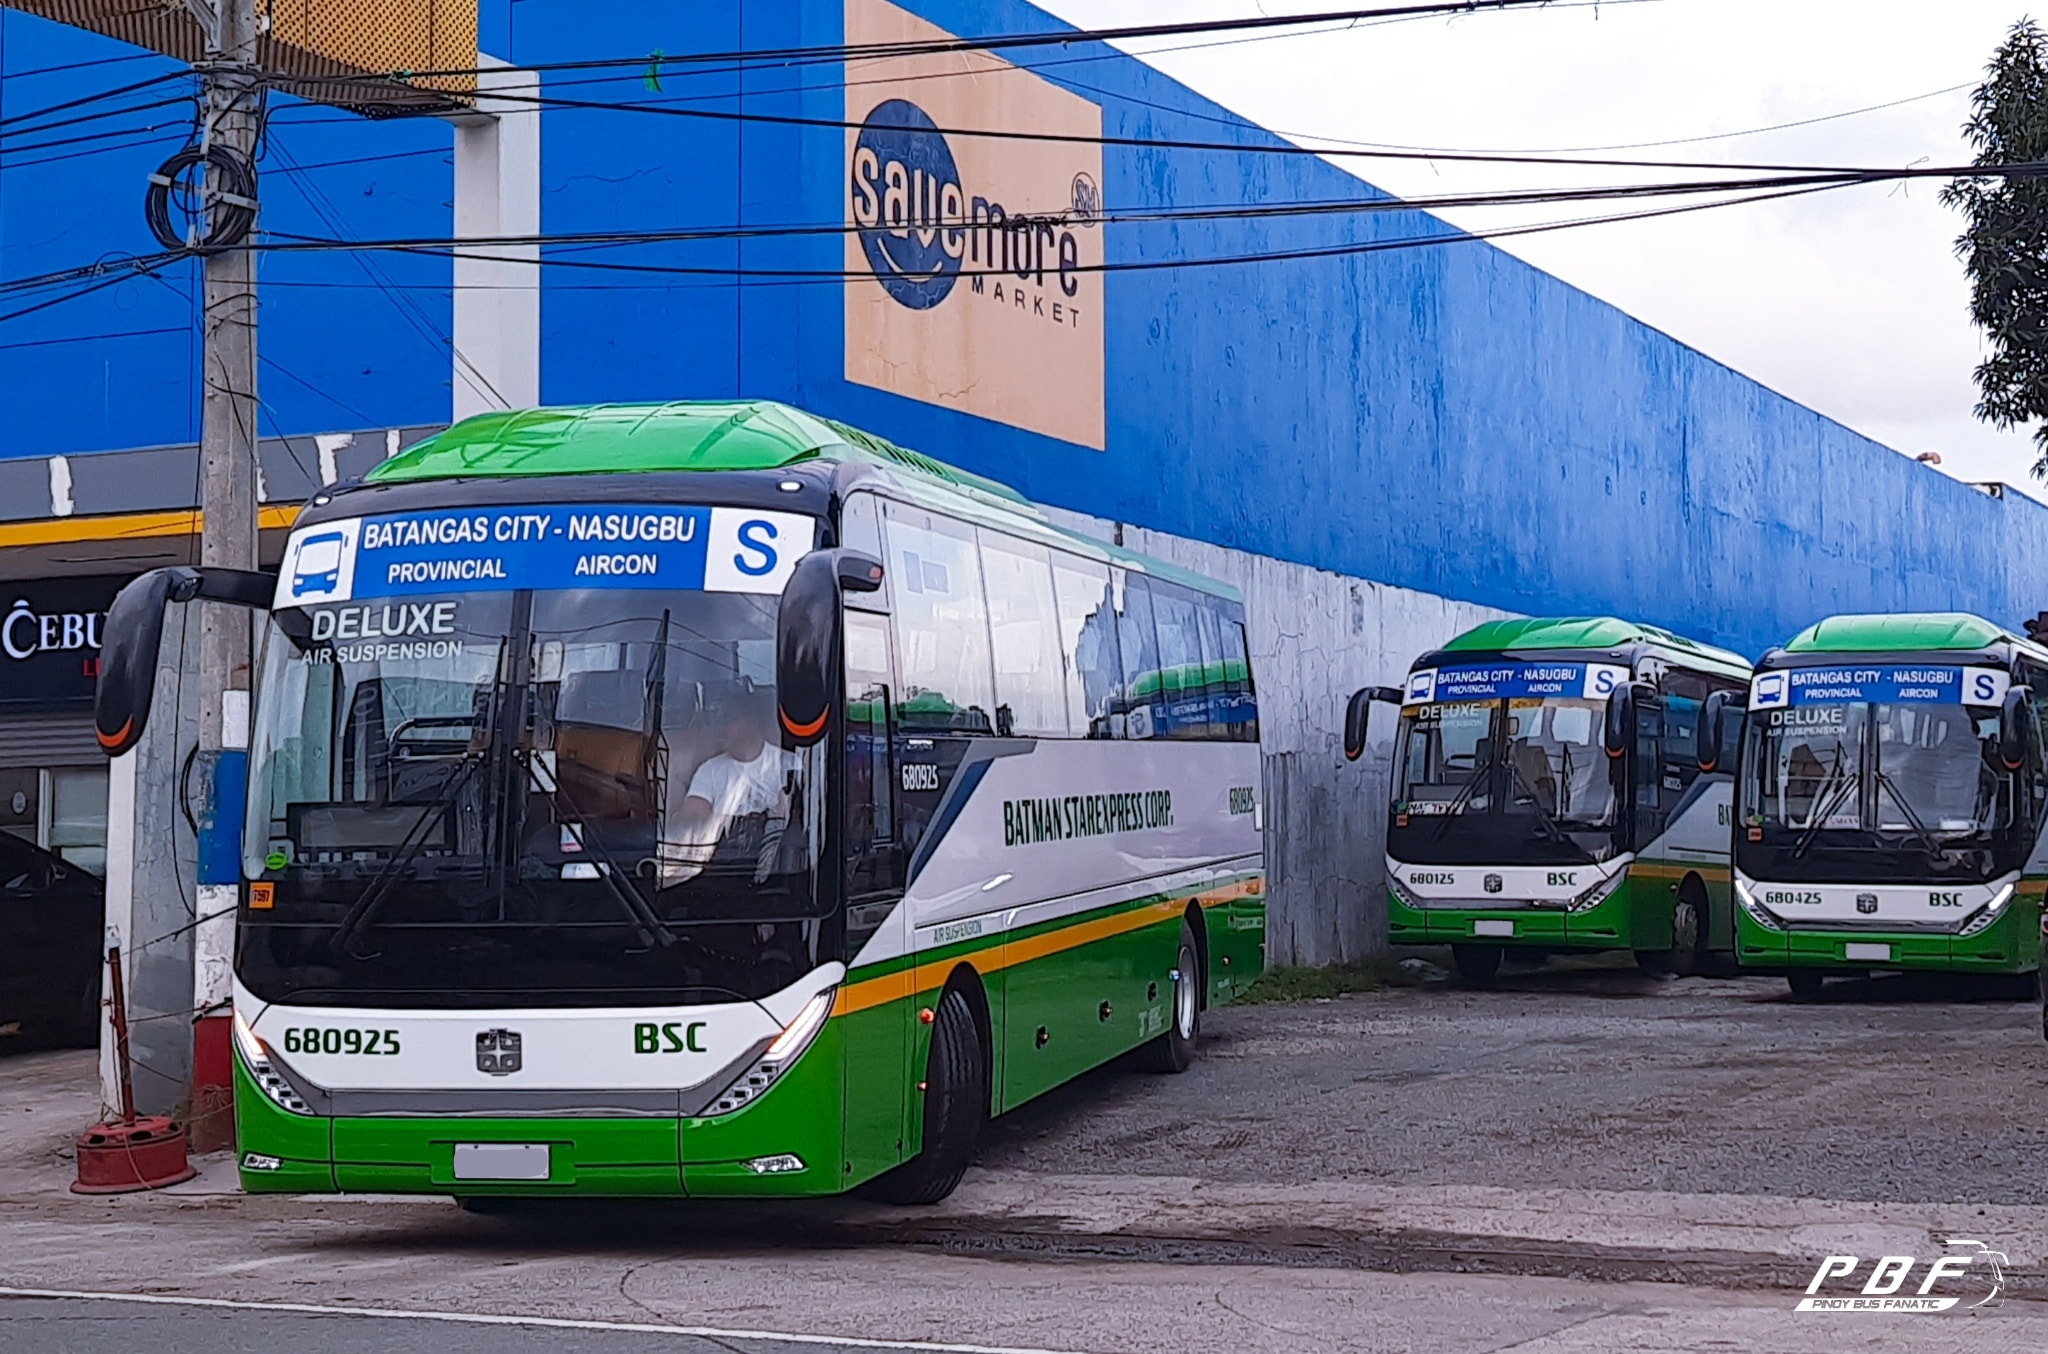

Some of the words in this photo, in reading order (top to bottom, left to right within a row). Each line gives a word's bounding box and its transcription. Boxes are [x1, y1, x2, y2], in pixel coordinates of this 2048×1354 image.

[971, 275, 1080, 328] MARKET
[363, 516, 489, 550] BATANGAS
[494, 514, 551, 542] CITY
[568, 514, 696, 543] NASUGBU
[734, 519, 778, 577] S
[387, 558, 507, 584] PROVINCIAL
[574, 553, 657, 576] AIRCON
[311, 602, 457, 642] DELUXE
[301, 647, 333, 666] AIR
[336, 640, 463, 665] SUSPENSION
[1437, 670, 1489, 685] BATANGAS
[1490, 669, 1515, 683] CITY
[1523, 668, 1577, 682] NASUGBU
[1594, 670, 1615, 694] S
[1791, 671, 1852, 686] BATANGAS
[1854, 670, 1881, 684] CITY
[1893, 670, 1954, 684] NASUGBU
[1973, 674, 1995, 700] S
[1447, 684, 1496, 695] PROVINCIAL
[1527, 683, 1562, 694] AIRCON
[1805, 687, 1863, 699] PROVINCIAL
[1898, 688, 1939, 699] AIRCON
[1419, 702, 1481, 720] DELUXE
[1770, 707, 1843, 727] DELUXE
[1766, 727, 1782, 737] AIR
[1784, 725, 1847, 737] SUSPENSION
[902, 764, 939, 791] 680925
[1003, 797, 1062, 847] BATMAN
[1064, 791, 1143, 840] STAREXPRESS
[1410, 873, 1454, 885] 680125
[1547, 872, 1577, 886] BSC
[1766, 891, 1822, 905] 680425
[1929, 892, 1964, 907] BSC
[284, 1027, 401, 1056] 680925
[634, 1022, 707, 1054] BSC
